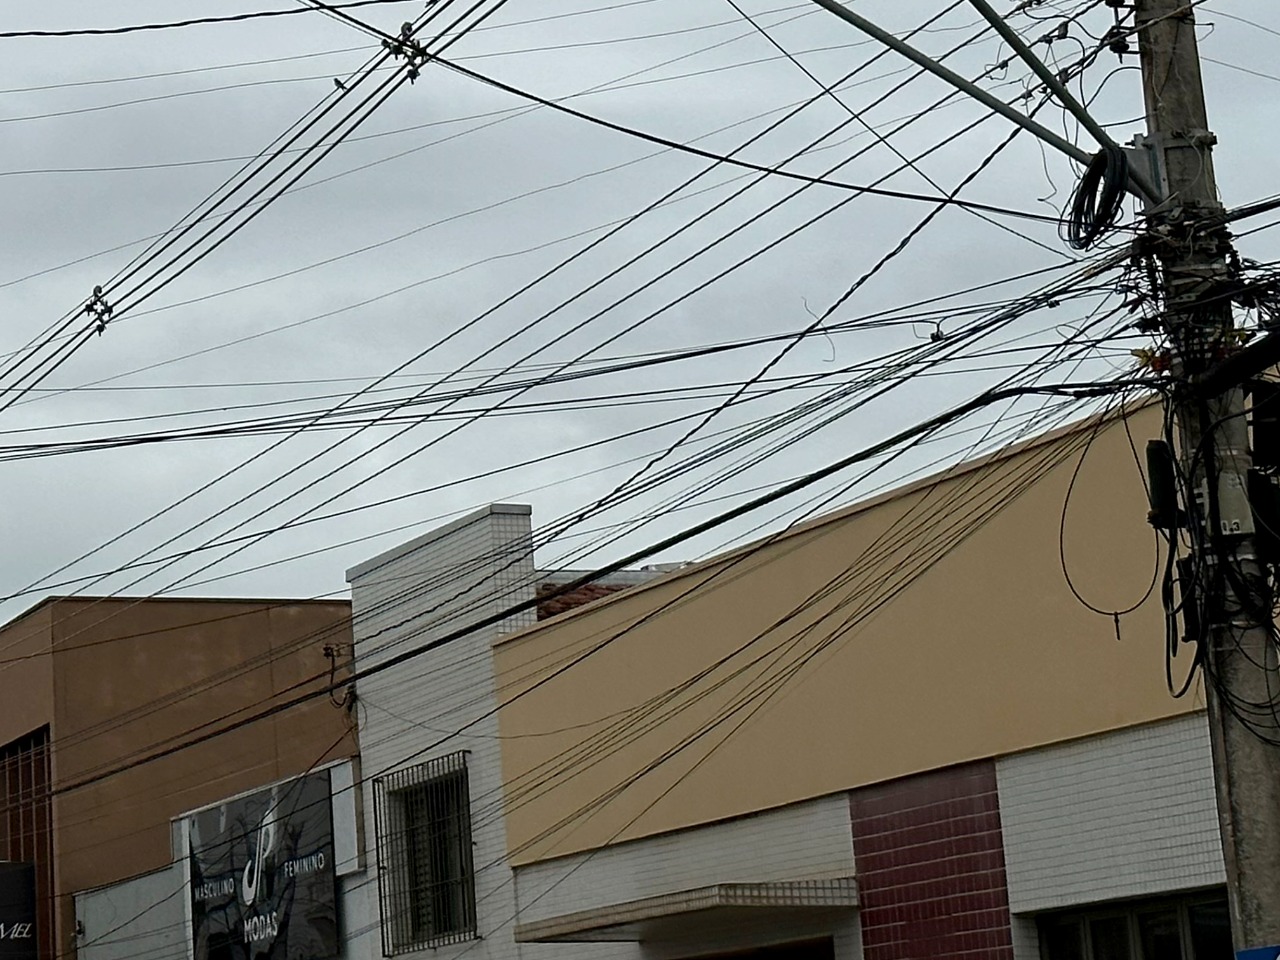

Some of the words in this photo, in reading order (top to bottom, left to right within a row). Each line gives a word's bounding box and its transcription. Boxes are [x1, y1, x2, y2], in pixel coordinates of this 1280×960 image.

[284, 852, 325, 878] FEMININO
[194, 878, 235, 901] MASCULINO
[244, 911, 278, 943] MODAS
